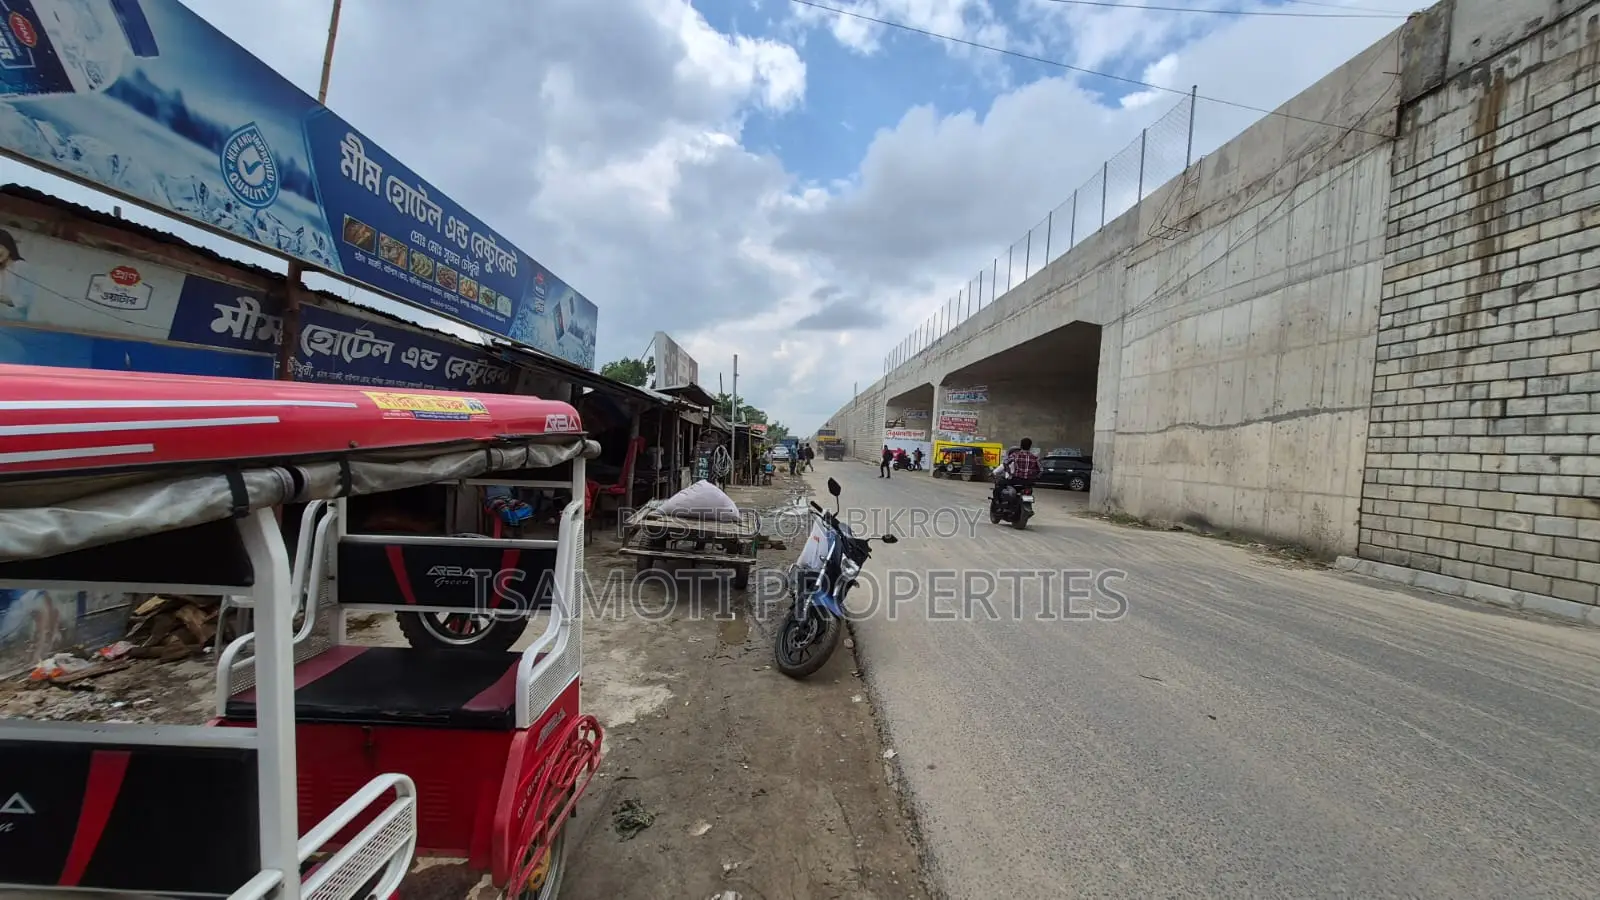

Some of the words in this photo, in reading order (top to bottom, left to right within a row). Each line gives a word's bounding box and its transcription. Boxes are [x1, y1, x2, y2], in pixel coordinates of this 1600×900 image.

[227, 141, 240, 162] NEW
[252, 133, 274, 181] IMPROVED
[229, 172, 269, 200] QUALITY
[340, 132, 382, 196] মীম
[386, 174, 443, 233] হোটেল
[445, 215, 470, 249] এন্ড
[210, 296, 284, 346] মীম
[300, 323, 395, 364] হোটেল
[401, 346, 442, 371] এন্ড
[544, 415, 578, 433] ARBA
[426, 565, 478, 577] ARBA
